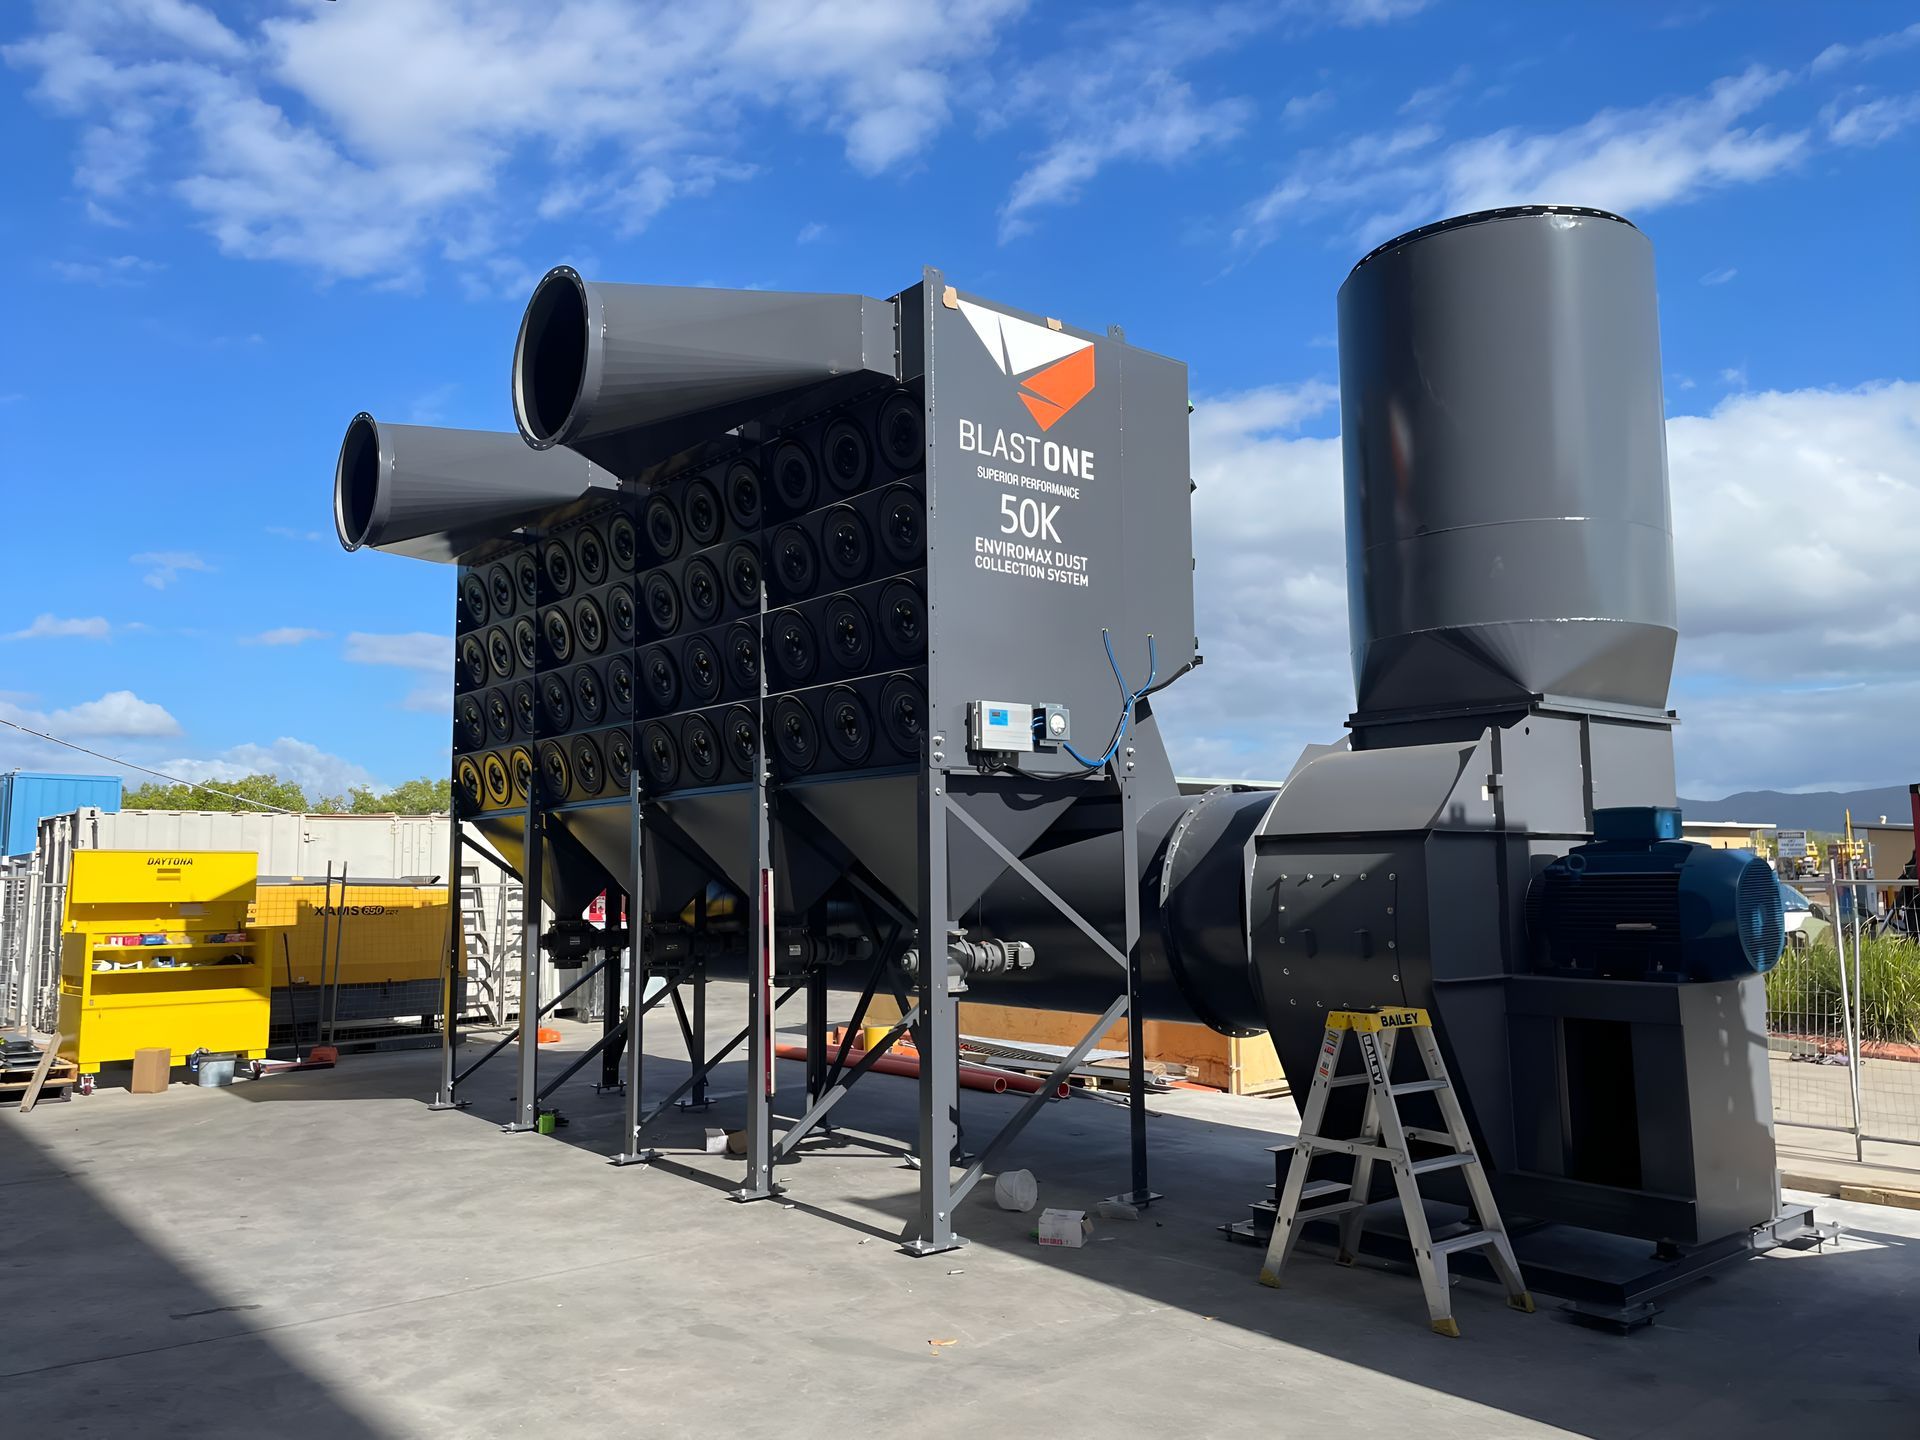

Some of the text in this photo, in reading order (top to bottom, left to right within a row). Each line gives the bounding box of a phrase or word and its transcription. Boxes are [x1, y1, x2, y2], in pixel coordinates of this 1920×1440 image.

[976, 465, 1080, 500] SUPERIOR PERFORMANCE
[1000, 493, 1063, 544] 50K
[974, 555, 1089, 587] COLLECTION SYSTEM
[975, 536, 1089, 572] ENVIROMAX DUST
[147, 857, 193, 866] DAYTONA
[1380, 1012, 1418, 1027] BAILEY
[1363, 1035, 1383, 1084] BAILEY
